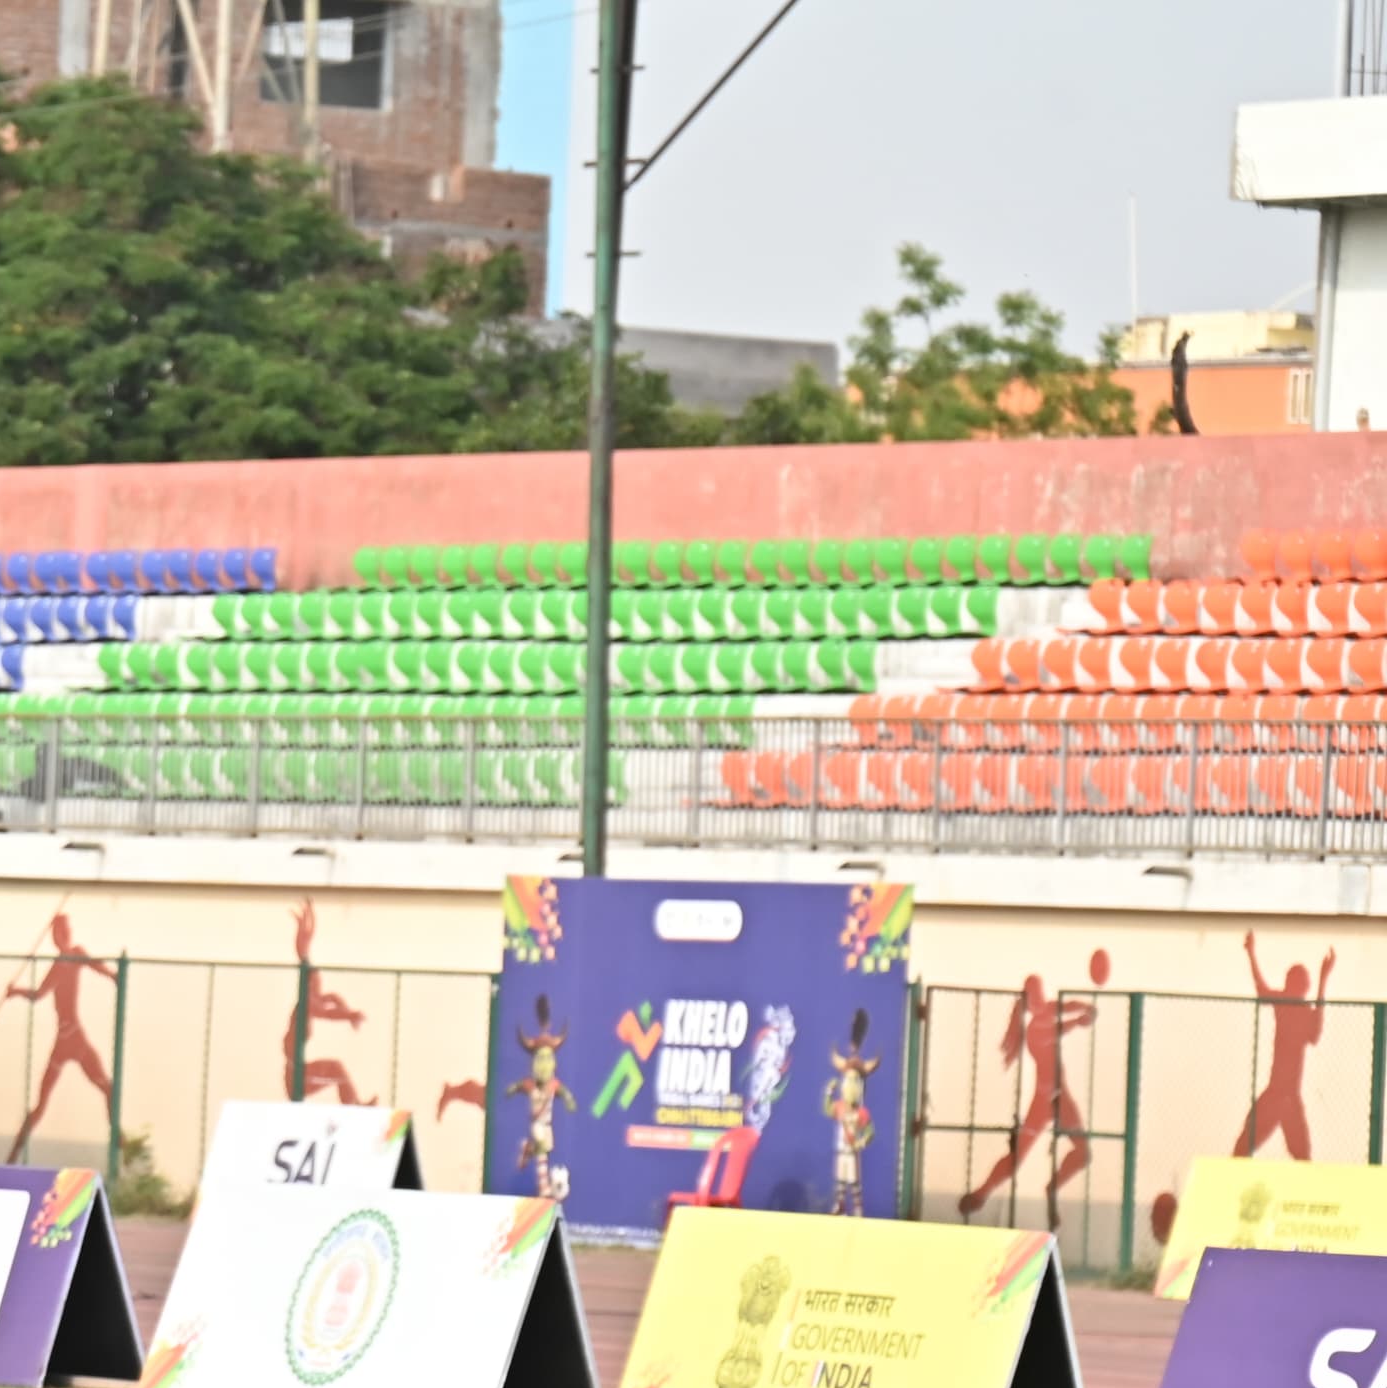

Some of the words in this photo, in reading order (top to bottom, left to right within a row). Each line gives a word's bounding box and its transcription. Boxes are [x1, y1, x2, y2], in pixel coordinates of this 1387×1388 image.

[663, 999, 748, 1049] KHELO
[658, 1048, 732, 1094] INDIA
[805, 1289, 842, 1313] भारत
[844, 1292, 896, 1318] सरकार
[792, 1322, 926, 1360] GOVERNMENT
[780, 1360, 808, 1387] OF
